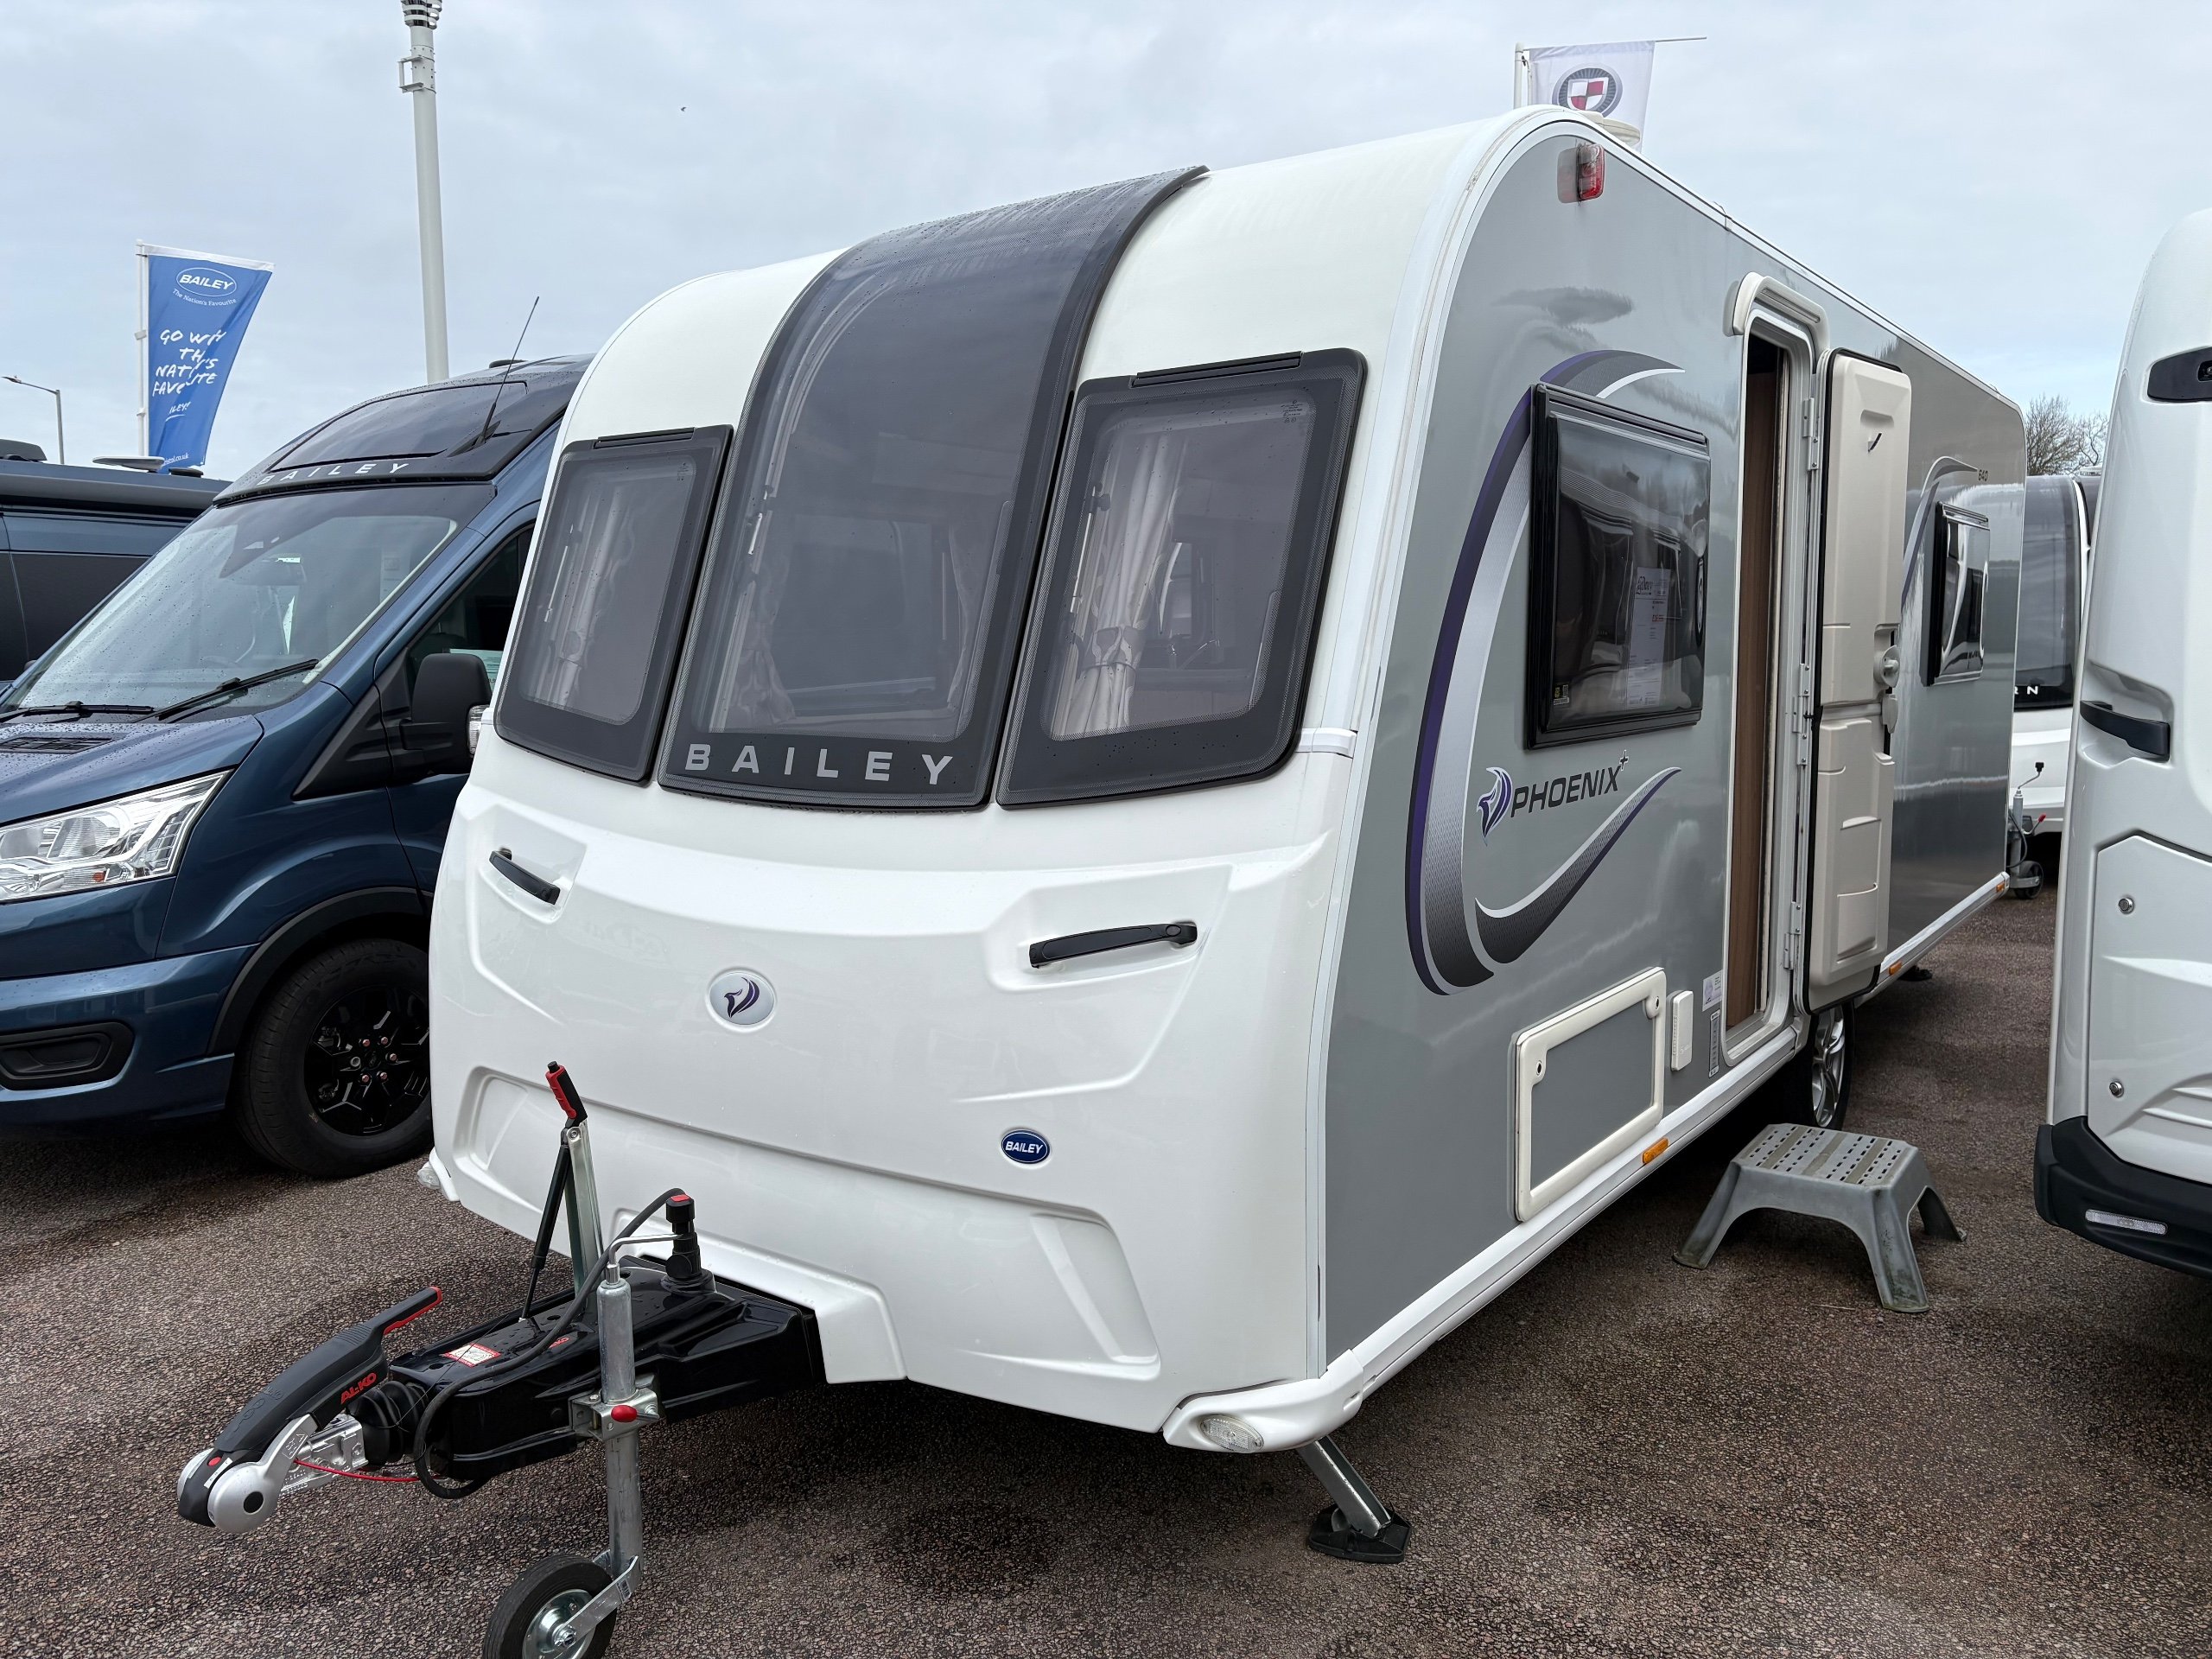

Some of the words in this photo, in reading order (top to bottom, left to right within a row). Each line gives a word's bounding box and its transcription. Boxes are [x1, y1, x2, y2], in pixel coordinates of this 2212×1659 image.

[179, 274, 234, 290] BAILEY
[172, 288, 182, 298] The
[183, 296, 207, 306] Nation's
[208, 298, 237, 307] Favourite
[160, 329, 183, 346] GO
[257, 463, 410, 486] BAILEY
[684, 743, 954, 785] BAILEY
[1005, 1141, 1044, 1154] BAILEY
[340, 1372, 377, 1405] AL-KO
